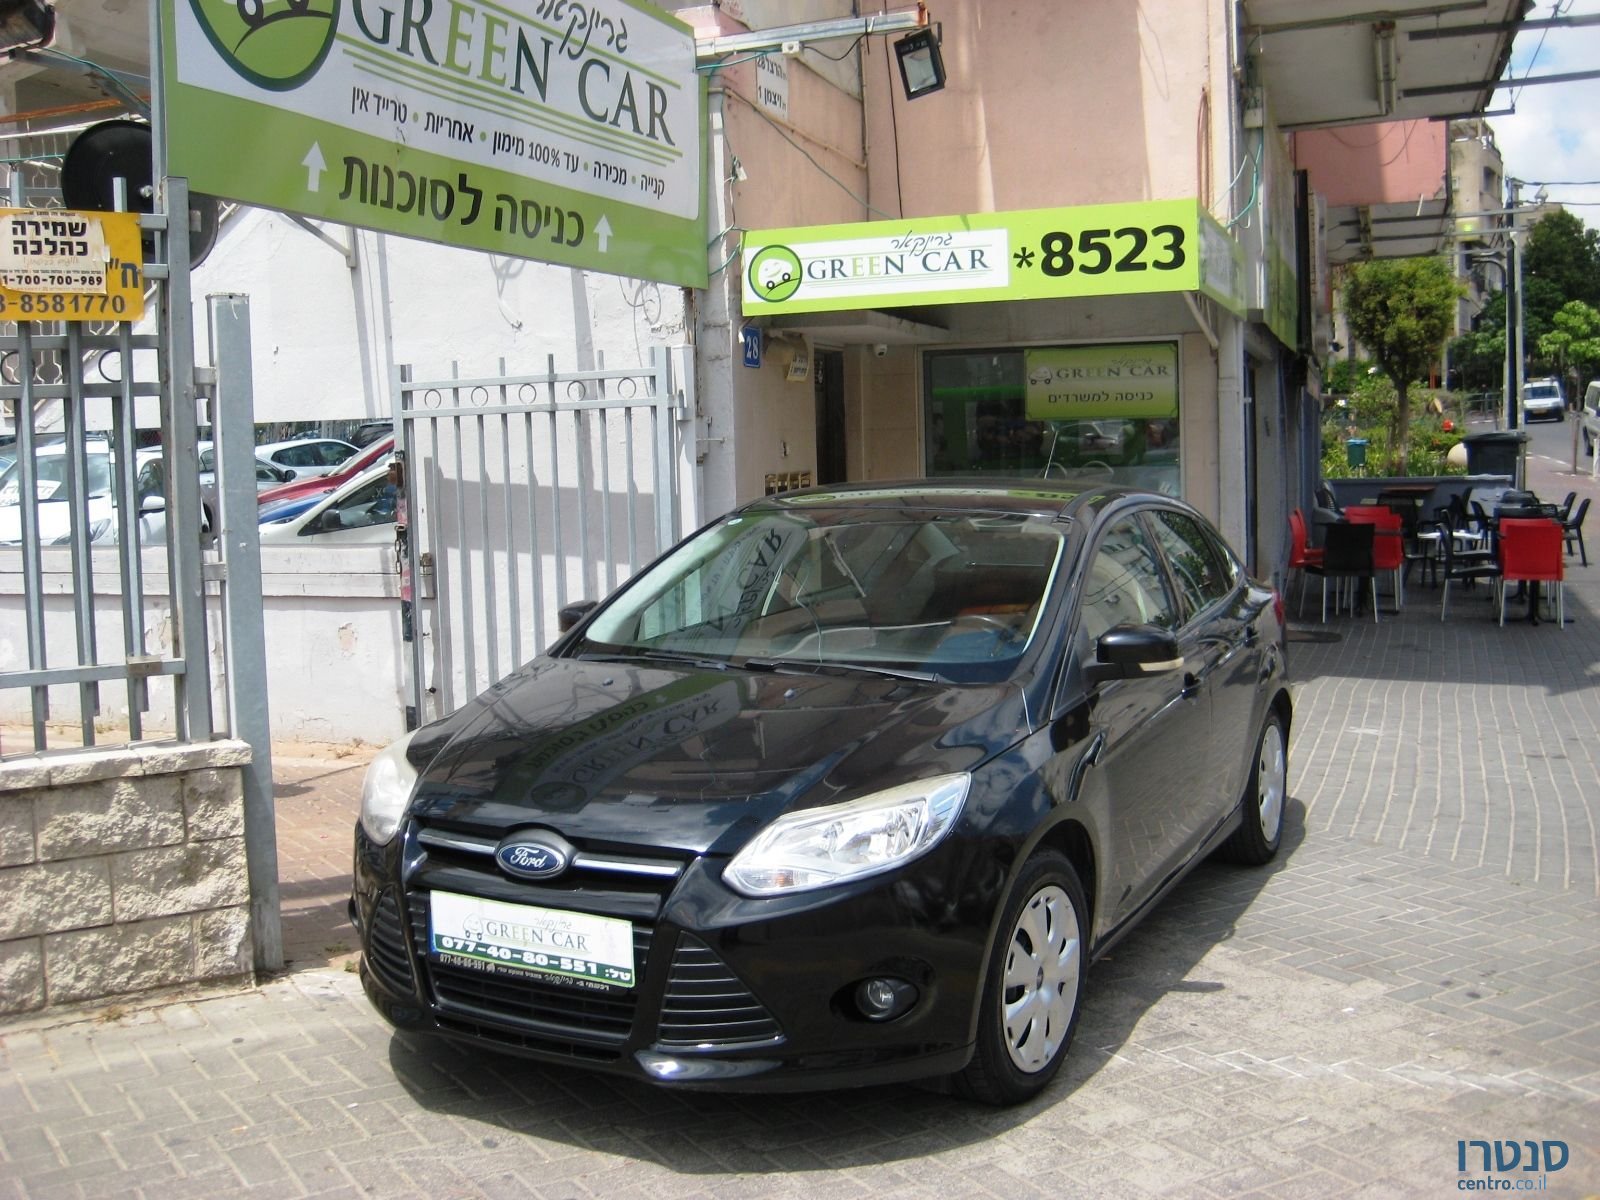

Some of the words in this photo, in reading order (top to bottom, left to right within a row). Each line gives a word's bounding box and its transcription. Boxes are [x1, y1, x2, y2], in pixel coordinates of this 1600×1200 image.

[352, 0, 553, 102] GREEN
[578, 57, 676, 146] CAR
[351, 86, 370, 115] אין
[373, 93, 408, 124] טרייד
[764, 87, 782, 108] ויצמן
[424, 111, 475, 144] אחריות
[492, 131, 525, 157] מימון
[528, 141, 561, 168] 100%
[563, 151, 580, 173] עד
[593, 160, 627, 186] מכירה
[338, 154, 484, 226] לסוכנות
[640, 174, 665, 200] קנייה
[12, 220, 87, 237] שמירה
[494, 191, 584, 248] כניסה
[13, 237, 89, 257] כהלכה
[806, 253, 905, 280] GREEN
[921, 248, 989, 273] CAR
[746, 335, 759, 360] 28
[1056, 366, 1121, 379] GREEN
[1129, 365, 1169, 377] CAR
[1048, 391, 1109, 404] למשרדים
[1115, 391, 1154, 401] כניסה
[509, 846, 546, 869] Ford
[486, 920, 544, 944] GREEN
[551, 930, 589, 951] CAR
[440, 935, 598, 976] 077-40-80-551
[604, 967, 631, 981] טל:
